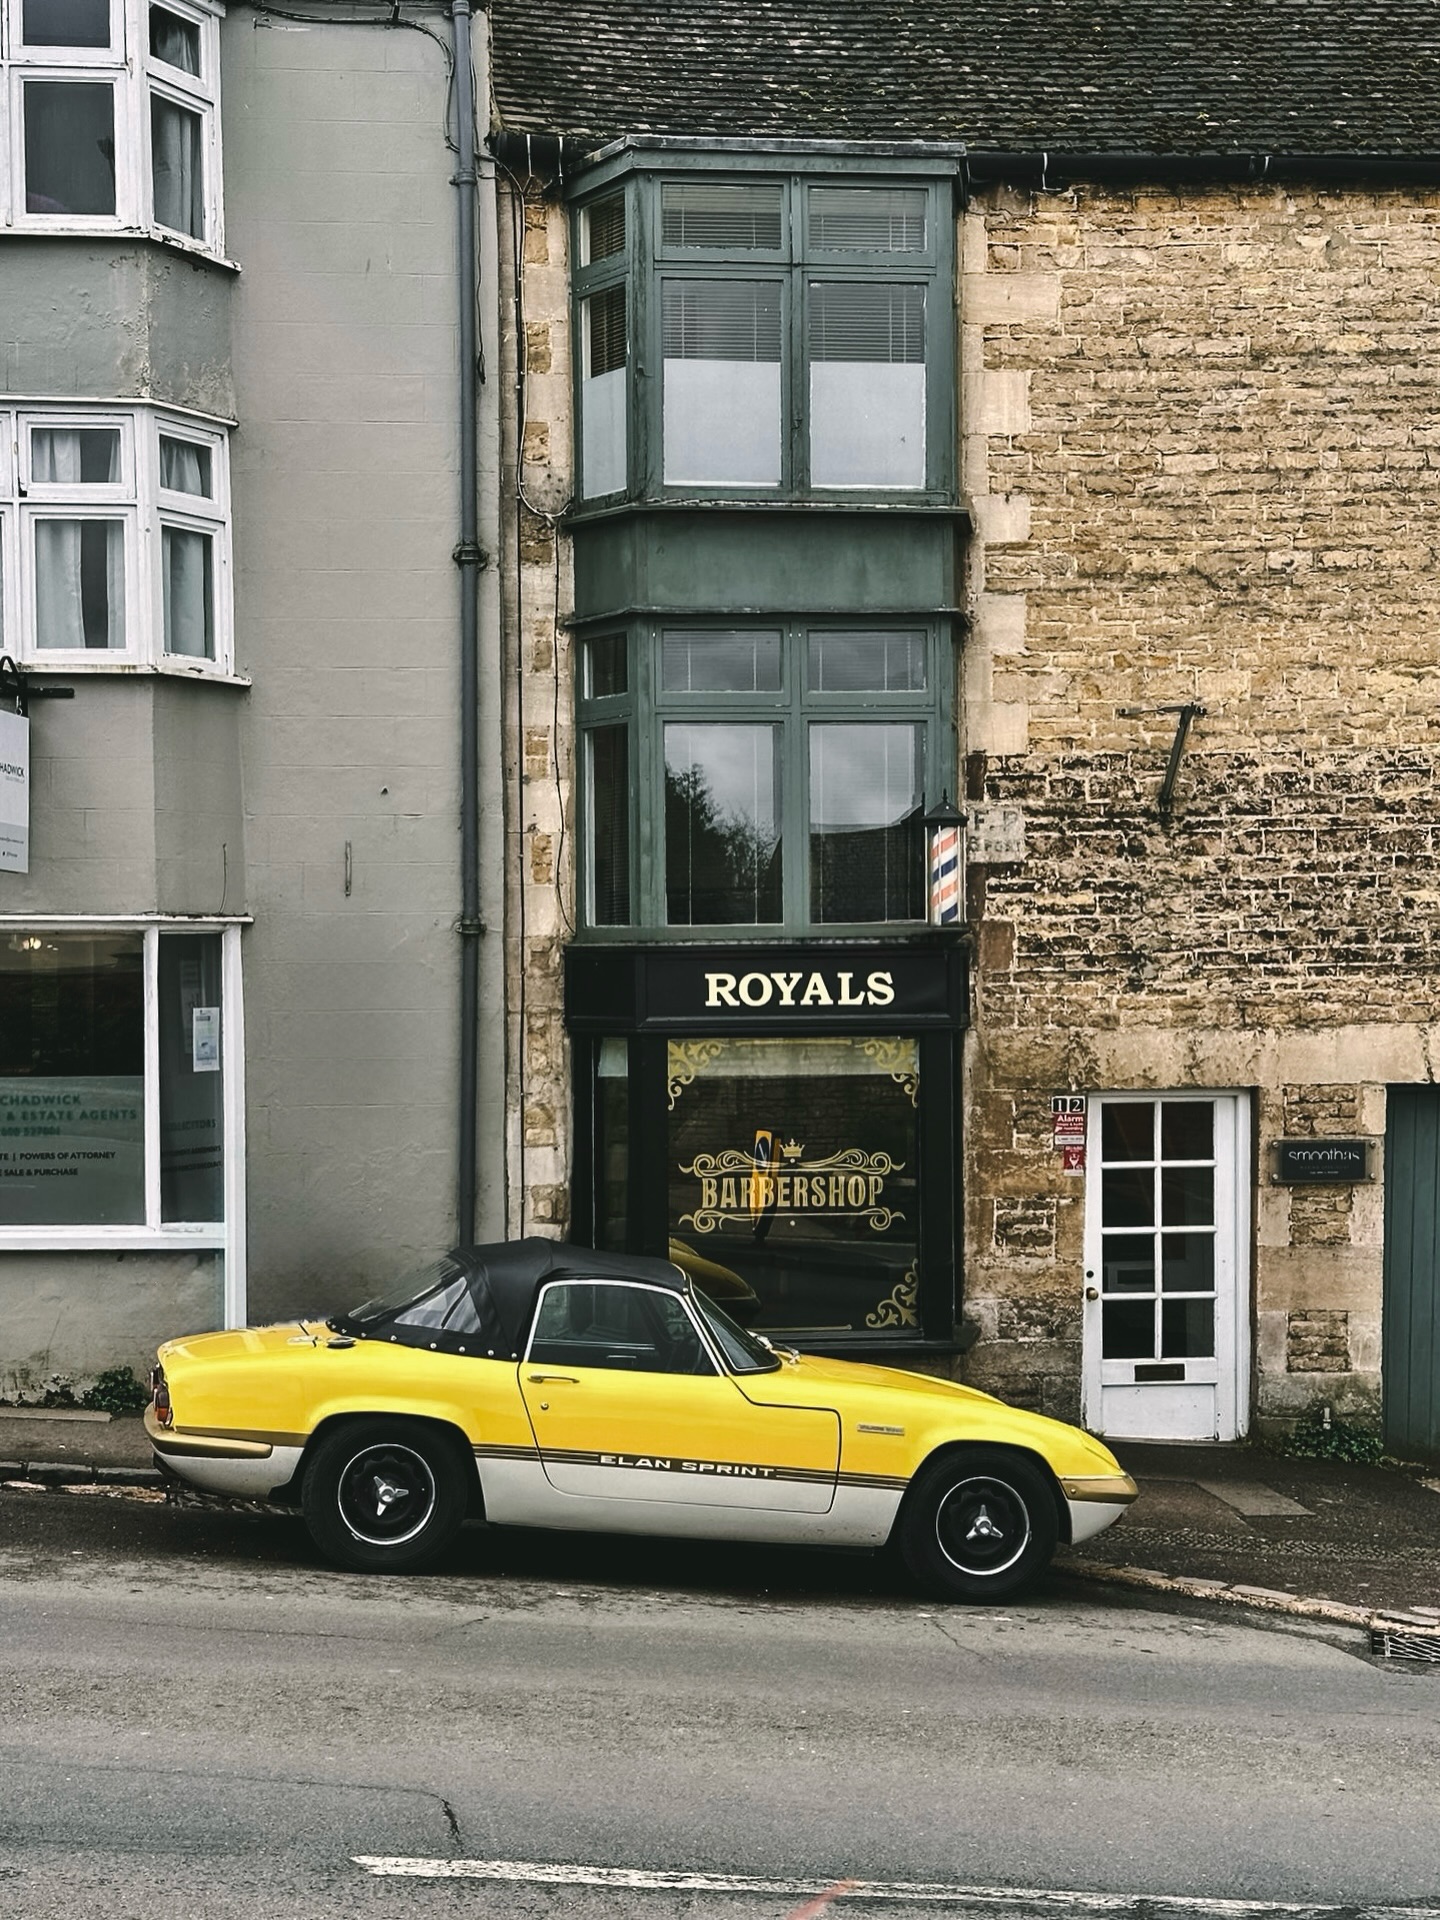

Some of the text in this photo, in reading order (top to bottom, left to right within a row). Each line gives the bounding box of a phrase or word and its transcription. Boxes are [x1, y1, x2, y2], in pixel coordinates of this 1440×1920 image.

[704, 972, 895, 1007] ROYALS
[0, 1094, 81, 1106] CHADWICK
[1058, 1099, 1082, 1112] 12
[22, 1109, 73, 1121] ESTATE
[79, 1109, 137, 1120] AGENTS
[1057, 1114, 1084, 1123] Alarm
[20, 1152, 56, 1160] POWERS
[57, 1152, 69, 1160] OF
[70, 1151, 116, 1159] ATTORNEY
[4, 1168, 24, 1177] SALE
[26, 1168, 33, 1177] &
[34, 1167, 78, 1176] PURCHASE
[702, 1175, 884, 1209] BARBERSHOP
[600, 1454, 774, 1477] ELAN SPRINT
